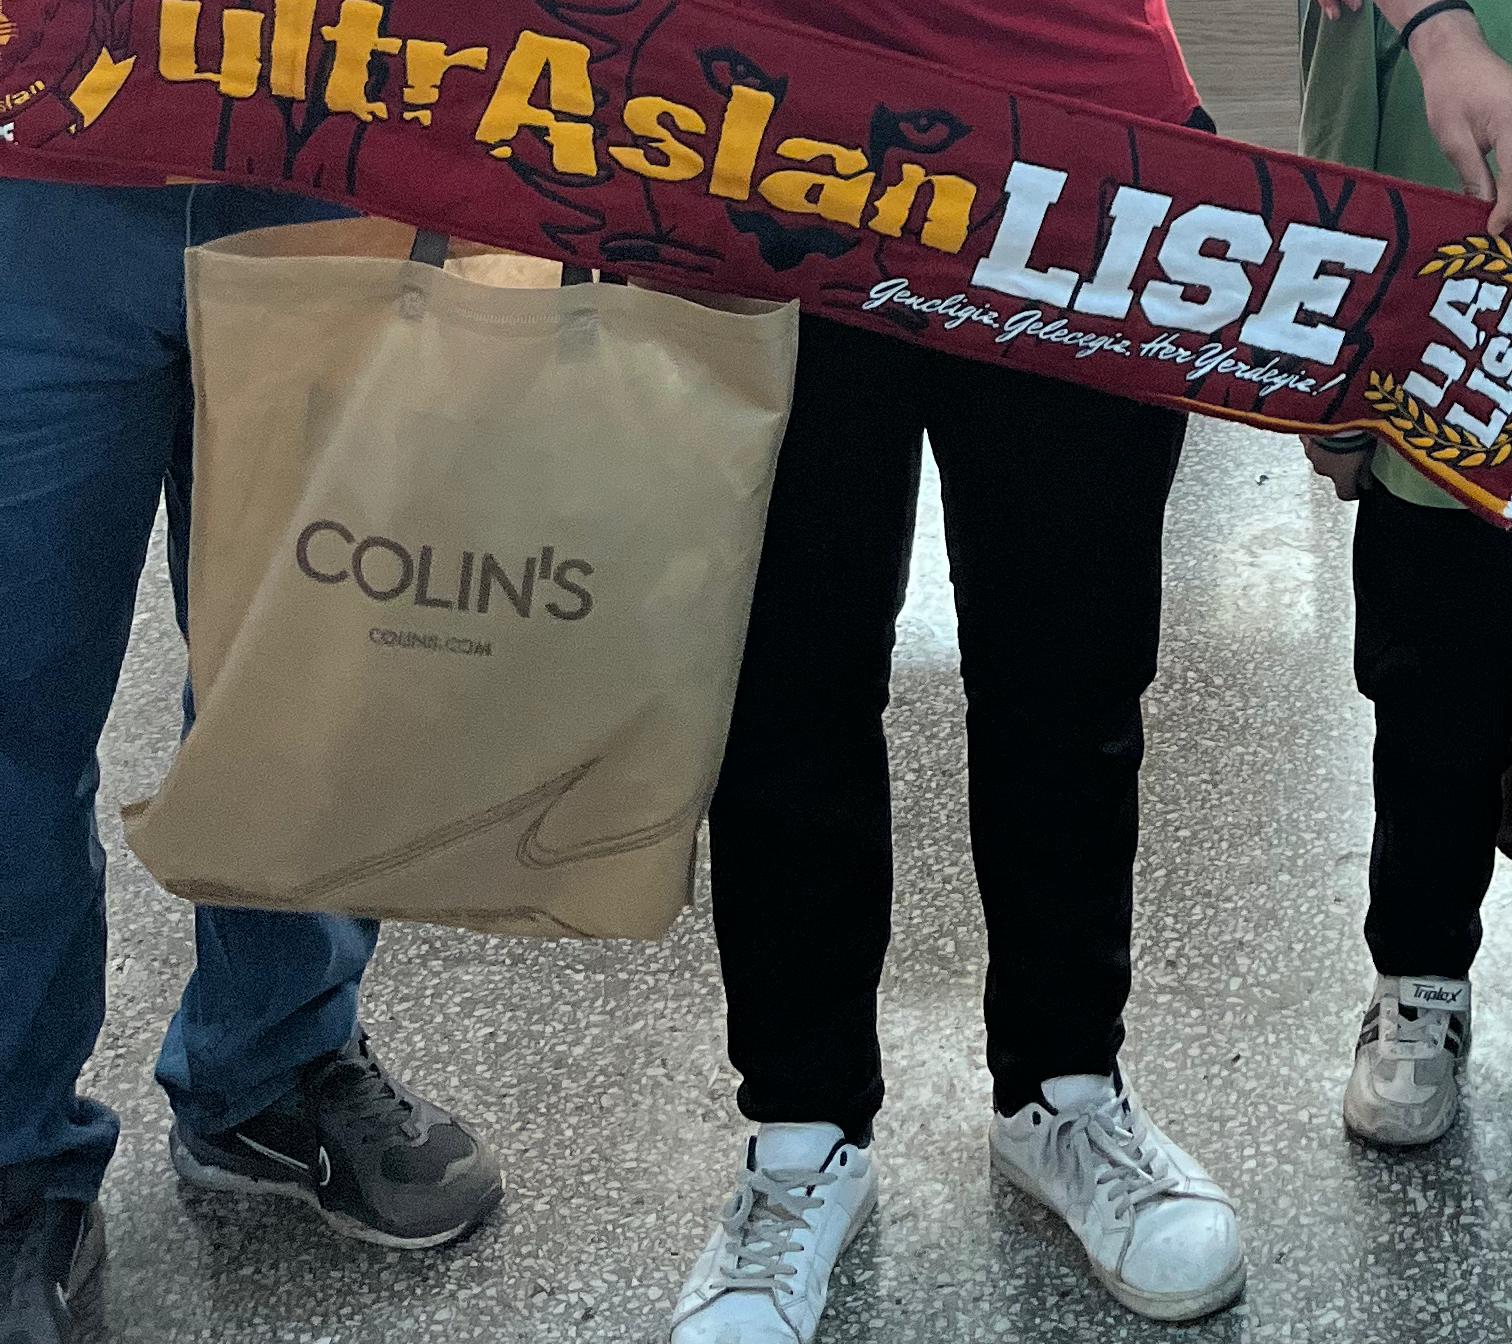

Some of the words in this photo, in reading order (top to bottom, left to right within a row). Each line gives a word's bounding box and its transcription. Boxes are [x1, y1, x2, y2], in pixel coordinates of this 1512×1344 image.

[971, 161, 1388, 365] LISE
[1140, 332, 1196, 363] Her
[296, 519, 595, 621] COLIN'S
